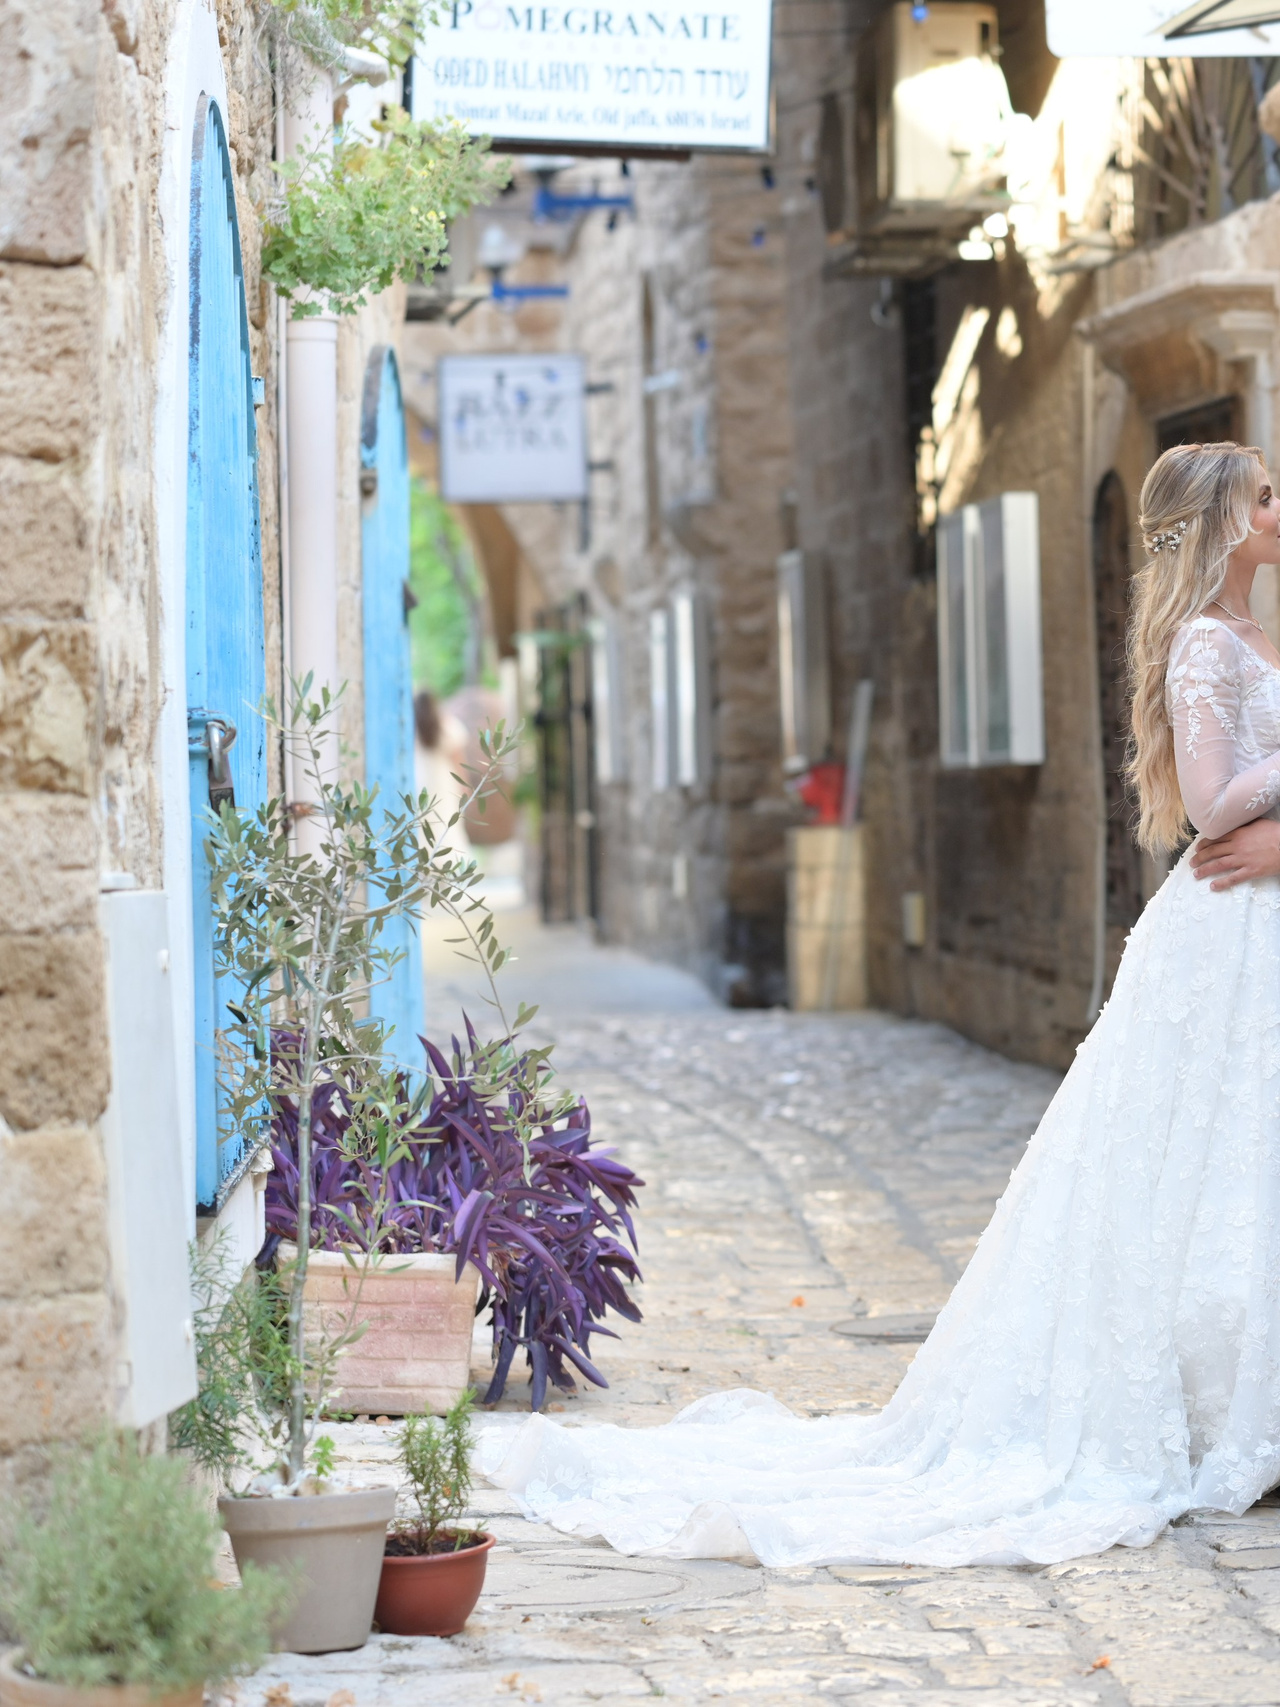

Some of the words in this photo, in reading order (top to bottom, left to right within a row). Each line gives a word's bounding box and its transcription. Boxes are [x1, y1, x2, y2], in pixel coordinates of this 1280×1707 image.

[450, 0, 742, 42] POMEGRANATE
[434, 56, 489, 89] ODED
[494, 58, 590, 92] HALAHMY
[604, 58, 685, 95] הלחמי
[694, 67, 750, 101] עודד
[592, 104, 619, 125] Old
[711, 109, 752, 131] Israel
